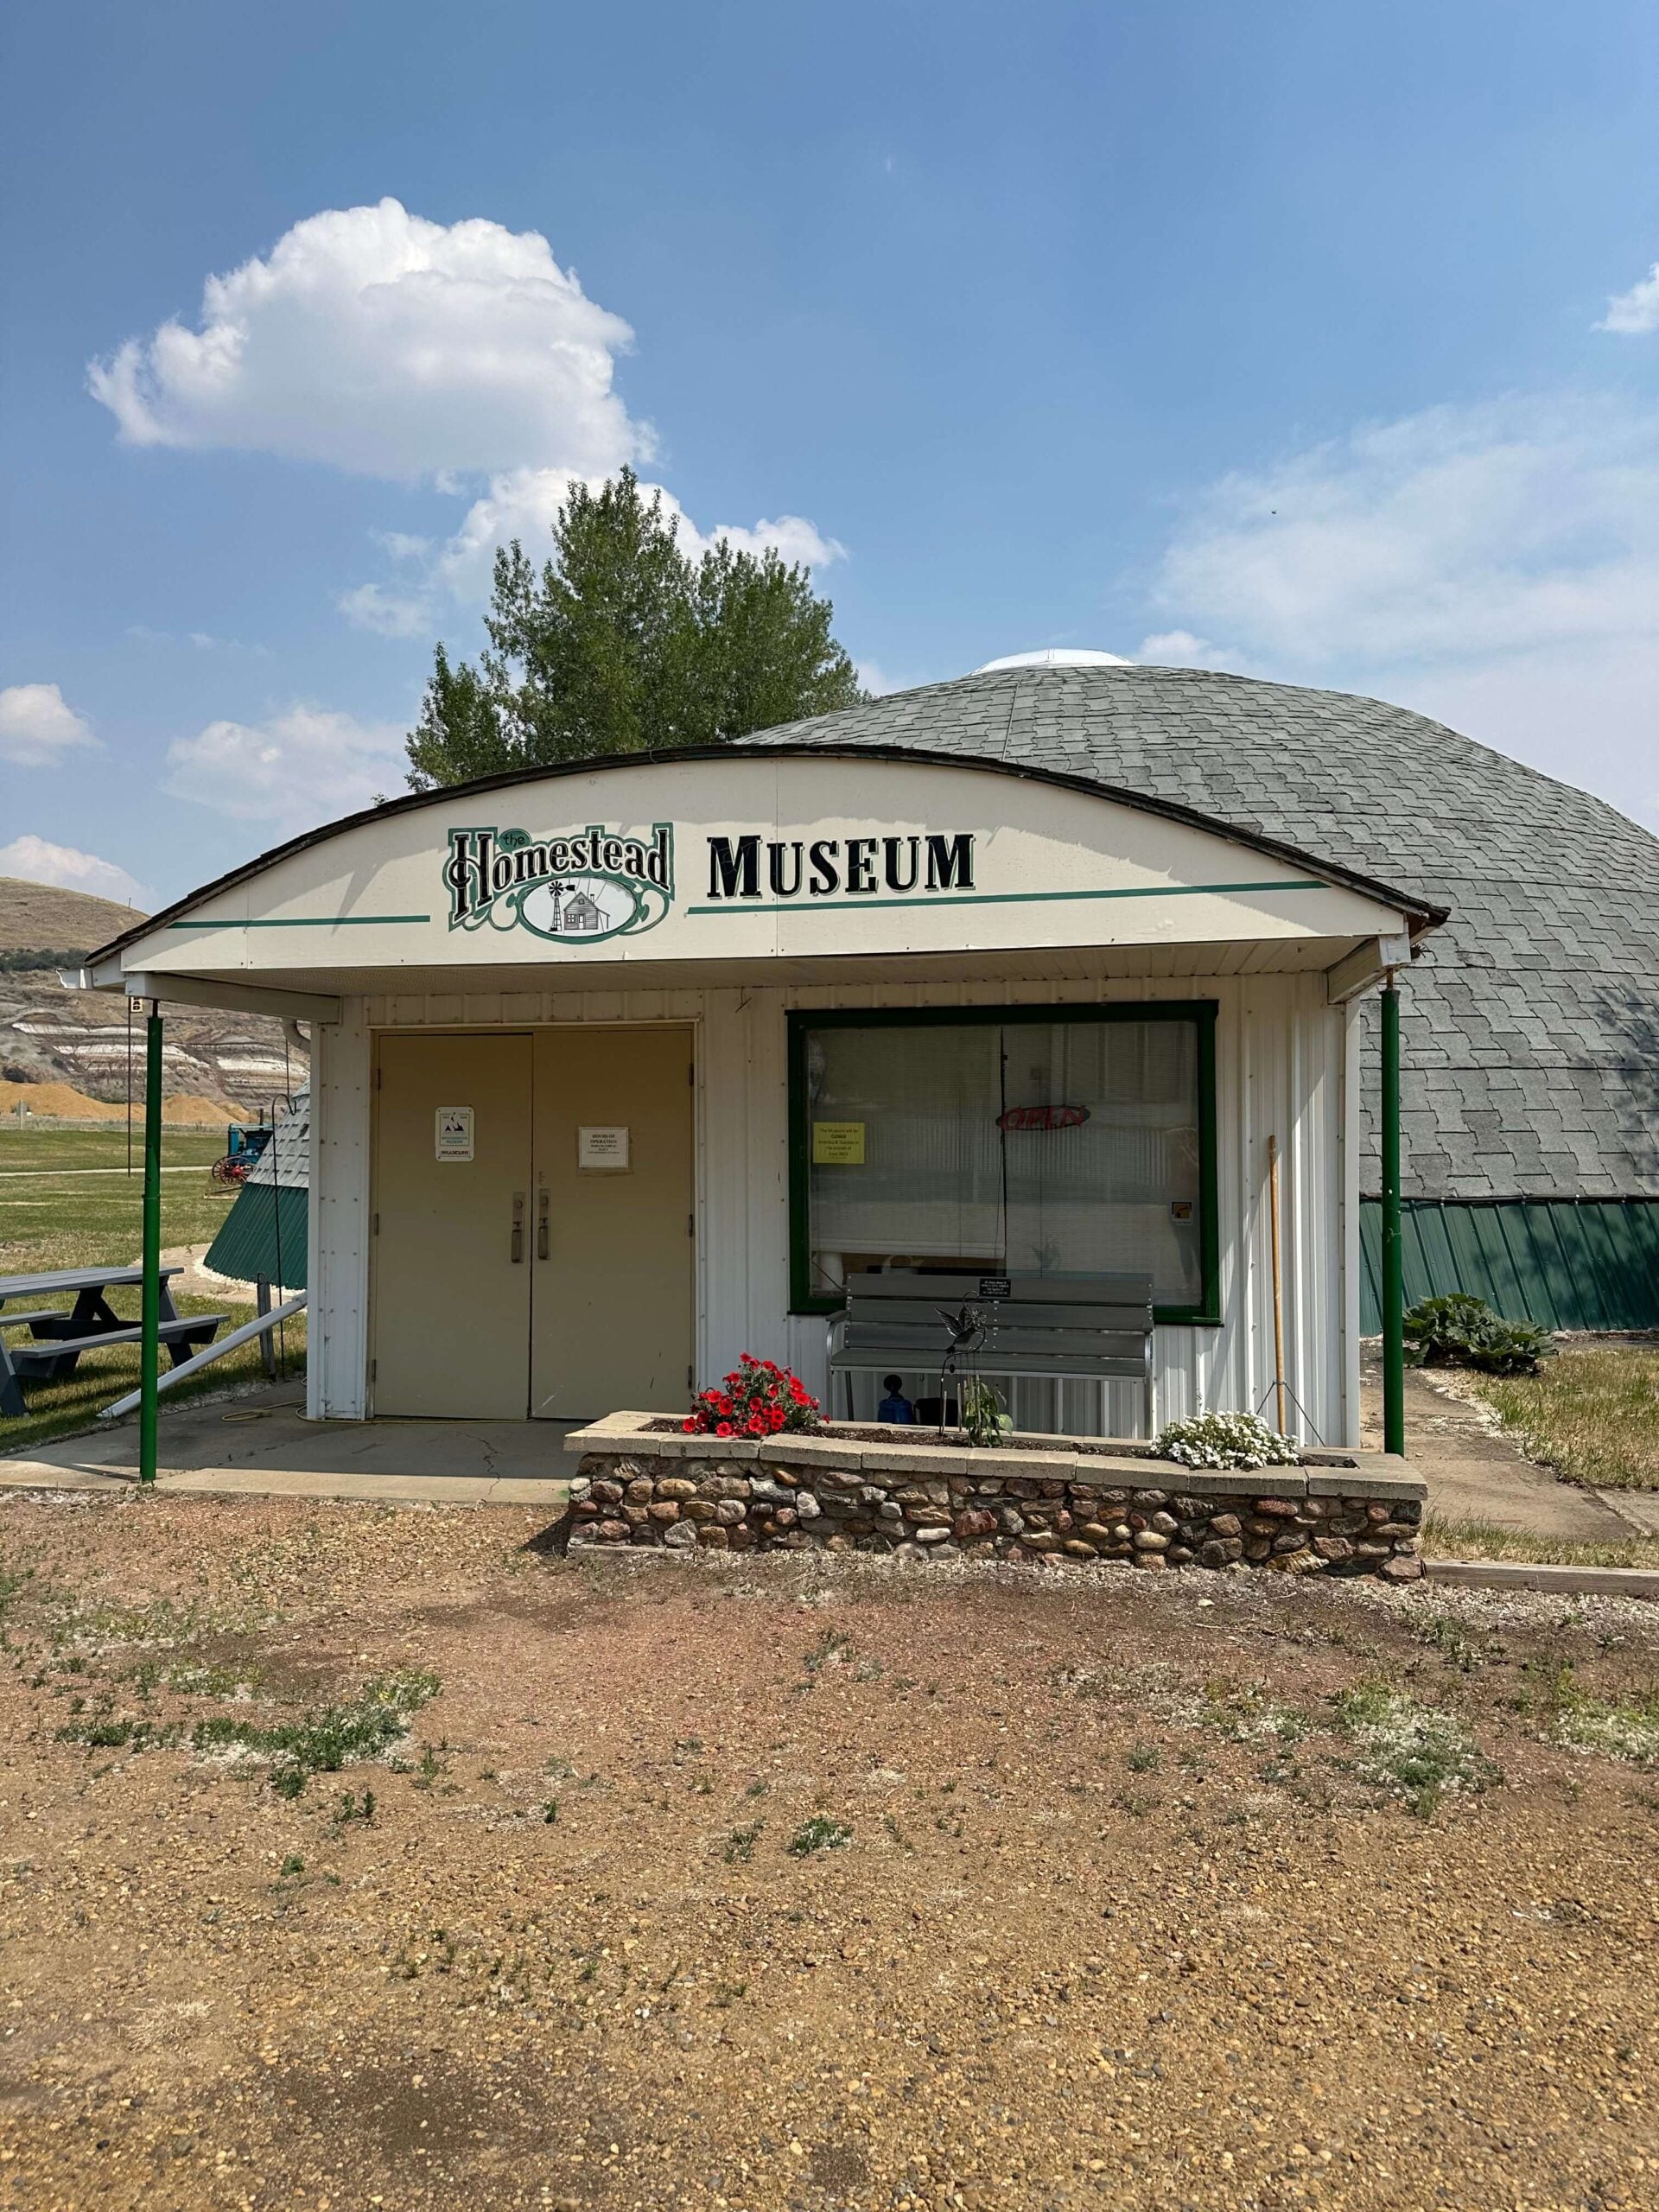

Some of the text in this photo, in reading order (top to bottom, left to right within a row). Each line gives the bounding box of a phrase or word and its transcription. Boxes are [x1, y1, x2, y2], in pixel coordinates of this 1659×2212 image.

[502, 830, 525, 848] the
[448, 829, 670, 922] Homestead
[707, 834, 976, 899] MUSEUM
[1001, 1105, 1086, 1131] OPEN
